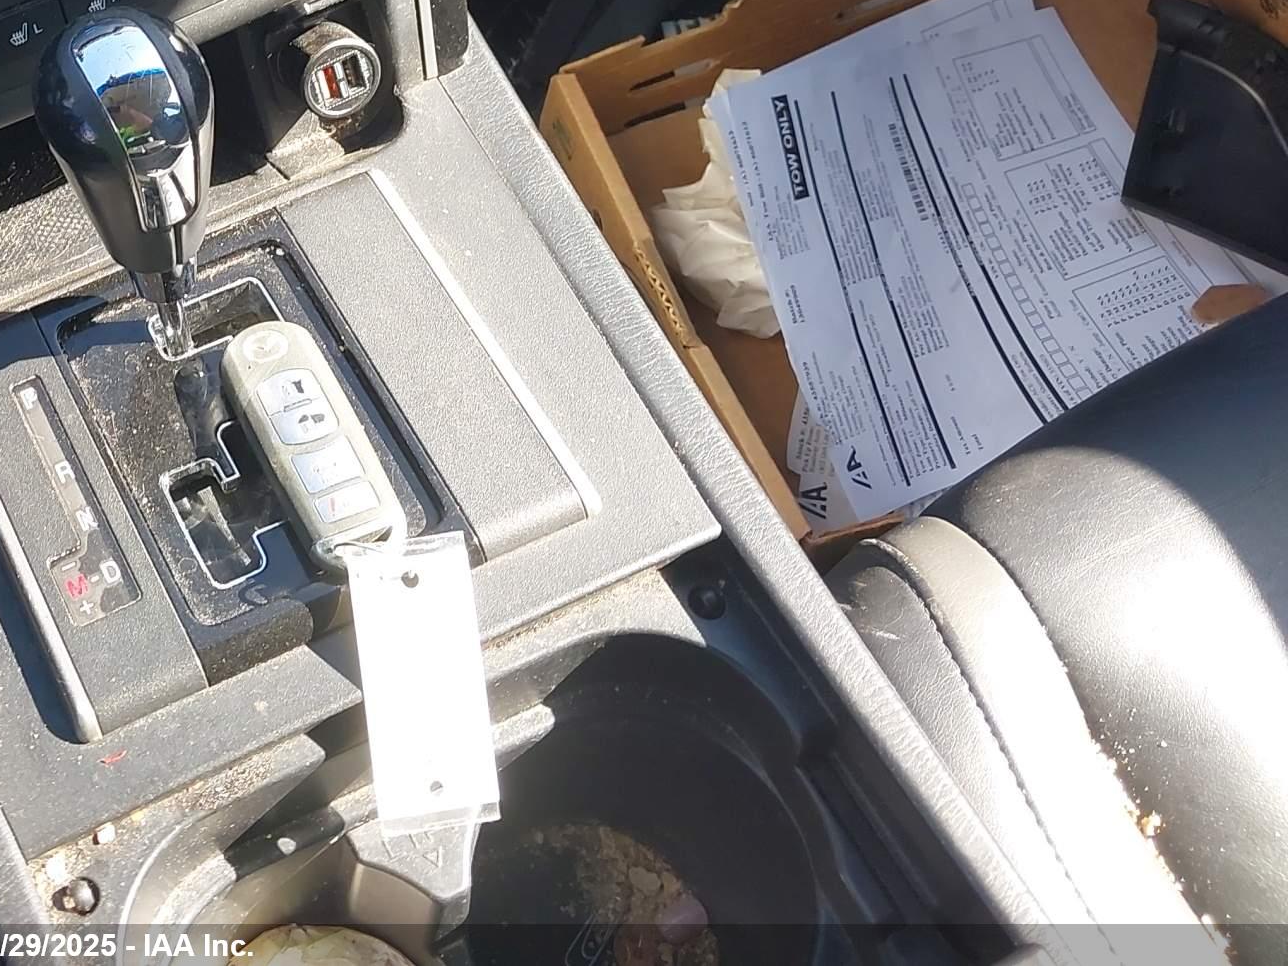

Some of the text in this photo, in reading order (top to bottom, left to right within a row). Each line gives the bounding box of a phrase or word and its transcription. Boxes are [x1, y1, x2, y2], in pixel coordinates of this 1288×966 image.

[32, 23, 44, 34] L
[774, 100, 792, 148] ONLY
[787, 154, 804, 193] TOW
[19, 387, 38, 410] P
[54, 461, 76, 483] R
[75, 506, 99, 532] N
[99, 560, 123, 584] D
[65, 572, 89, 600] M
